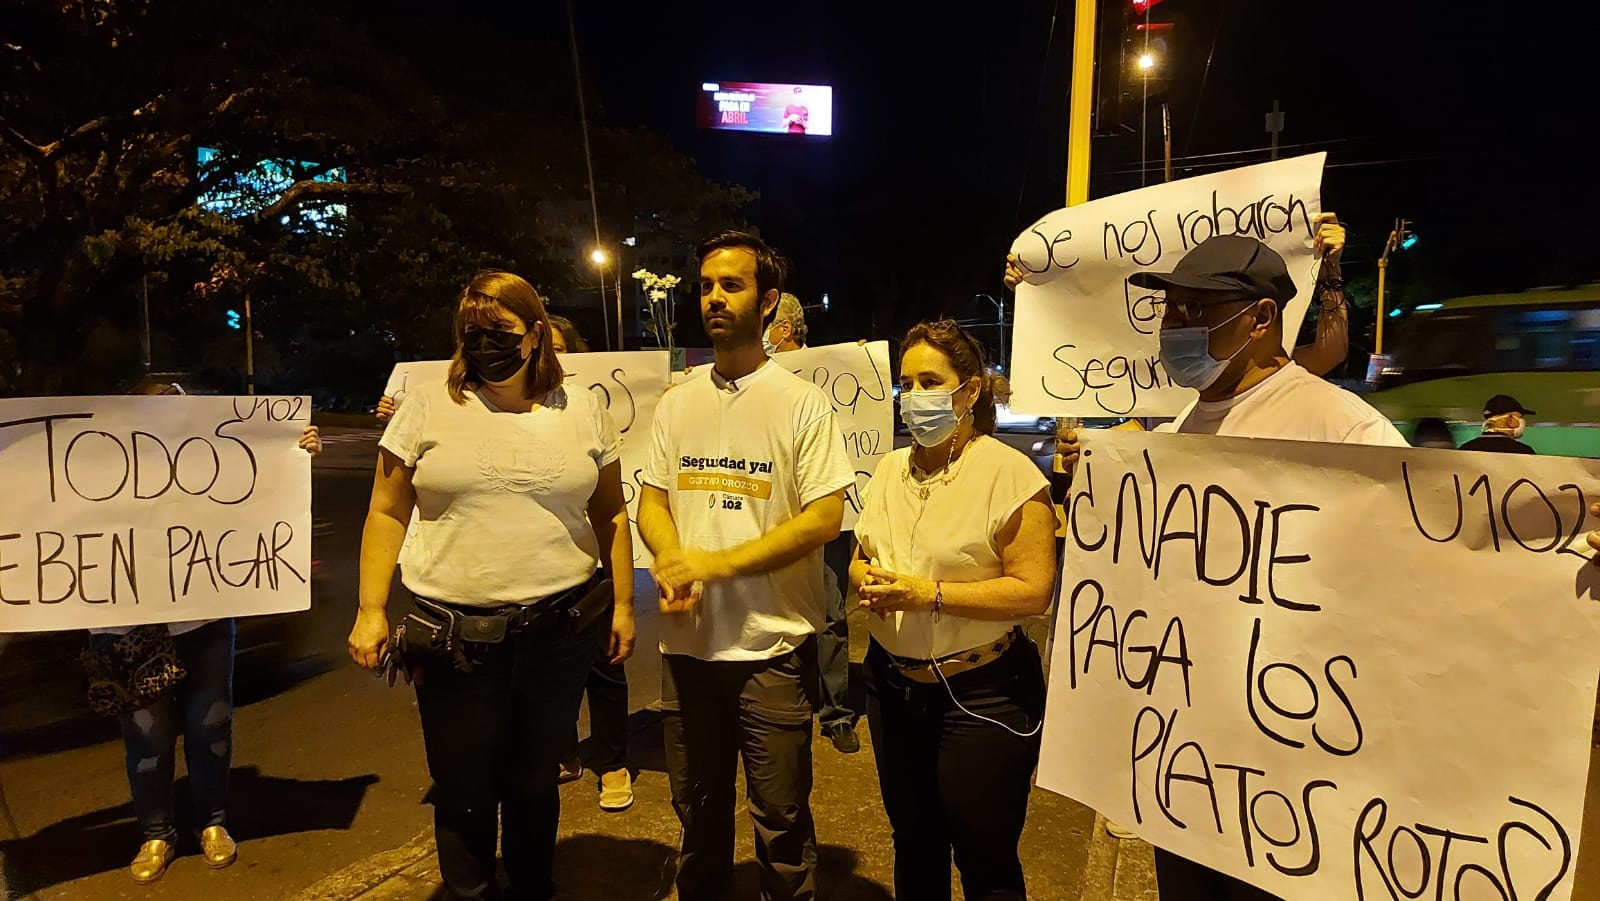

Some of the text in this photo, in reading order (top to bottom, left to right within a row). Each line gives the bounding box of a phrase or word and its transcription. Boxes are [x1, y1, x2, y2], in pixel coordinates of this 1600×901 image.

[721, 112, 748, 124] ABRIL
[1017, 190, 1313, 273] Se nos robaron
[233, 397, 307, 422] U102
[1042, 344, 1173, 415] Segur
[0, 413, 257, 504] TODOS
[722, 500, 742, 510] 102
[1070, 449, 1321, 612] ¿NADIE
[1402, 462, 1592, 560] U102
[167, 521, 306, 602] PAGAR
[1070, 579, 1363, 756] PAGA LOS
[1132, 706, 1337, 876] PLATOS
